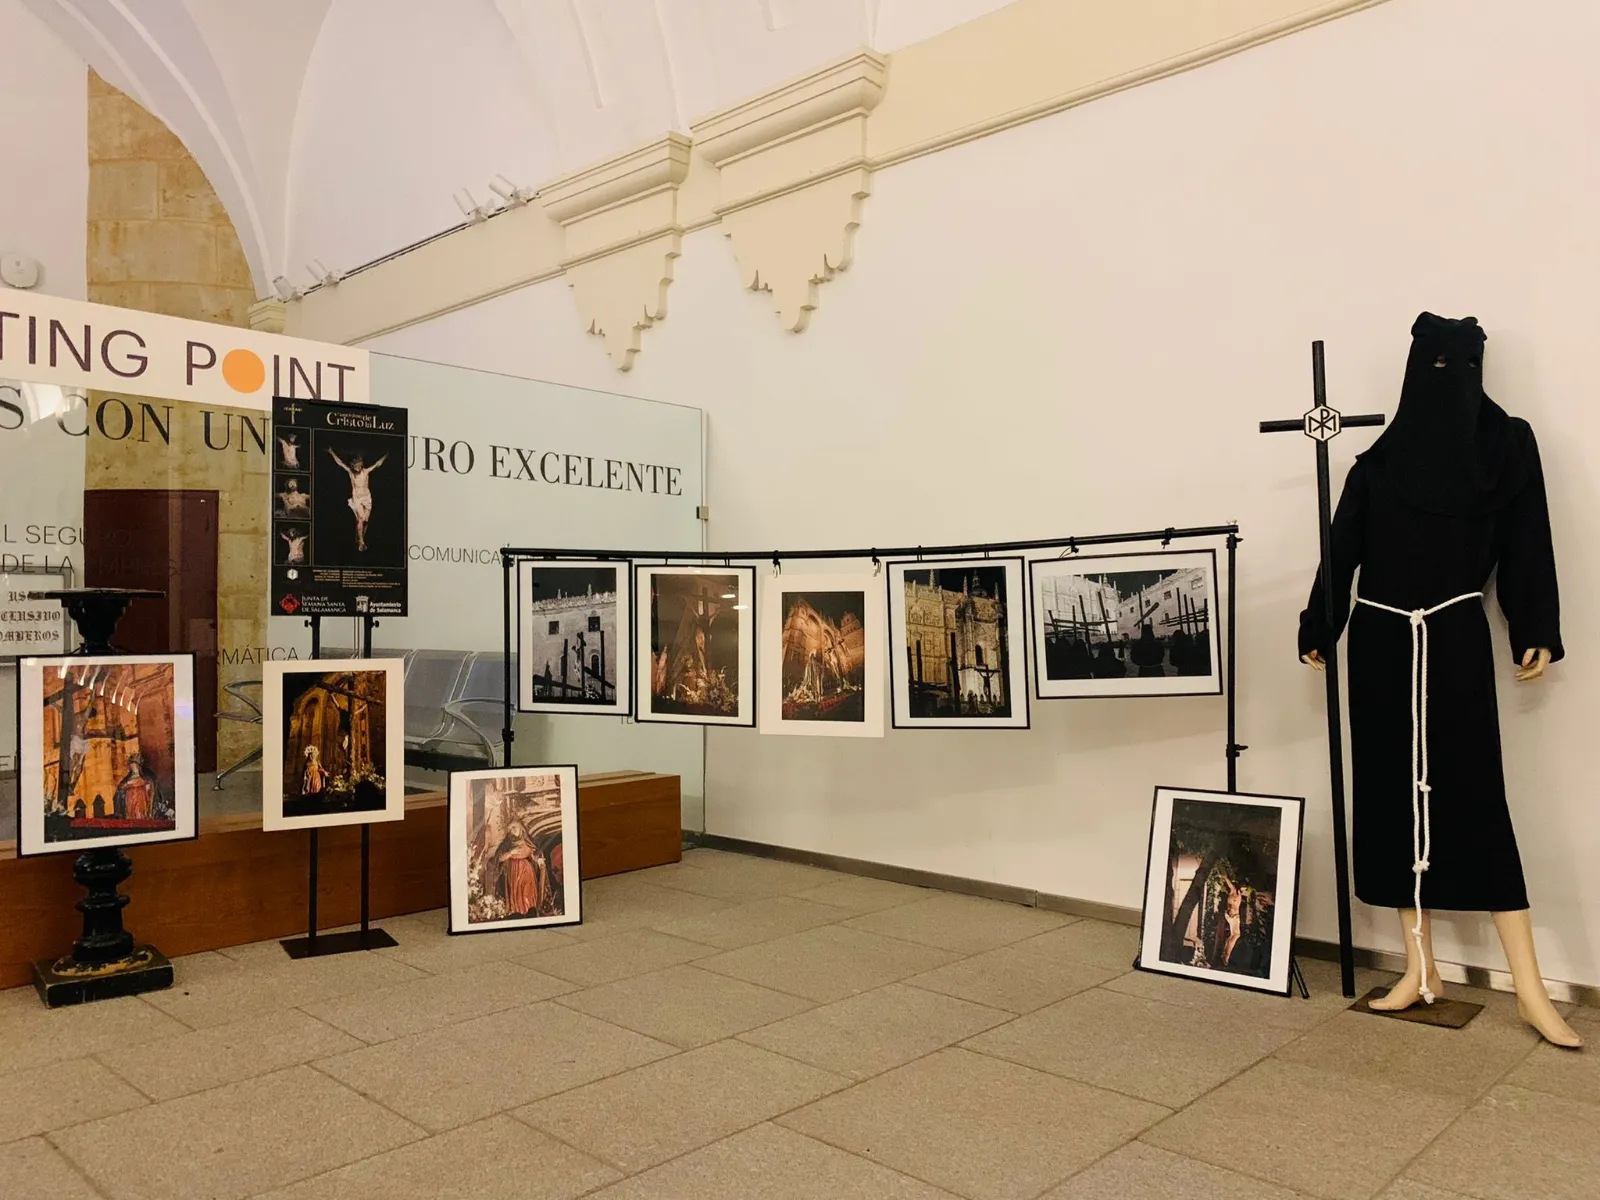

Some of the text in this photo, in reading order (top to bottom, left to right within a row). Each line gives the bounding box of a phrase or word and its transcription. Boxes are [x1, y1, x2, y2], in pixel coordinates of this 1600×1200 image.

[326, 411, 364, 428] Cristo
[373, 415, 395, 430] Luz
[57, 393, 174, 445] CON
[200, 410, 270, 455] UN
[489, 445, 683, 496] EXCELENTE
[2, 553, 35, 573] DE
[45, 554, 75, 574] LA
